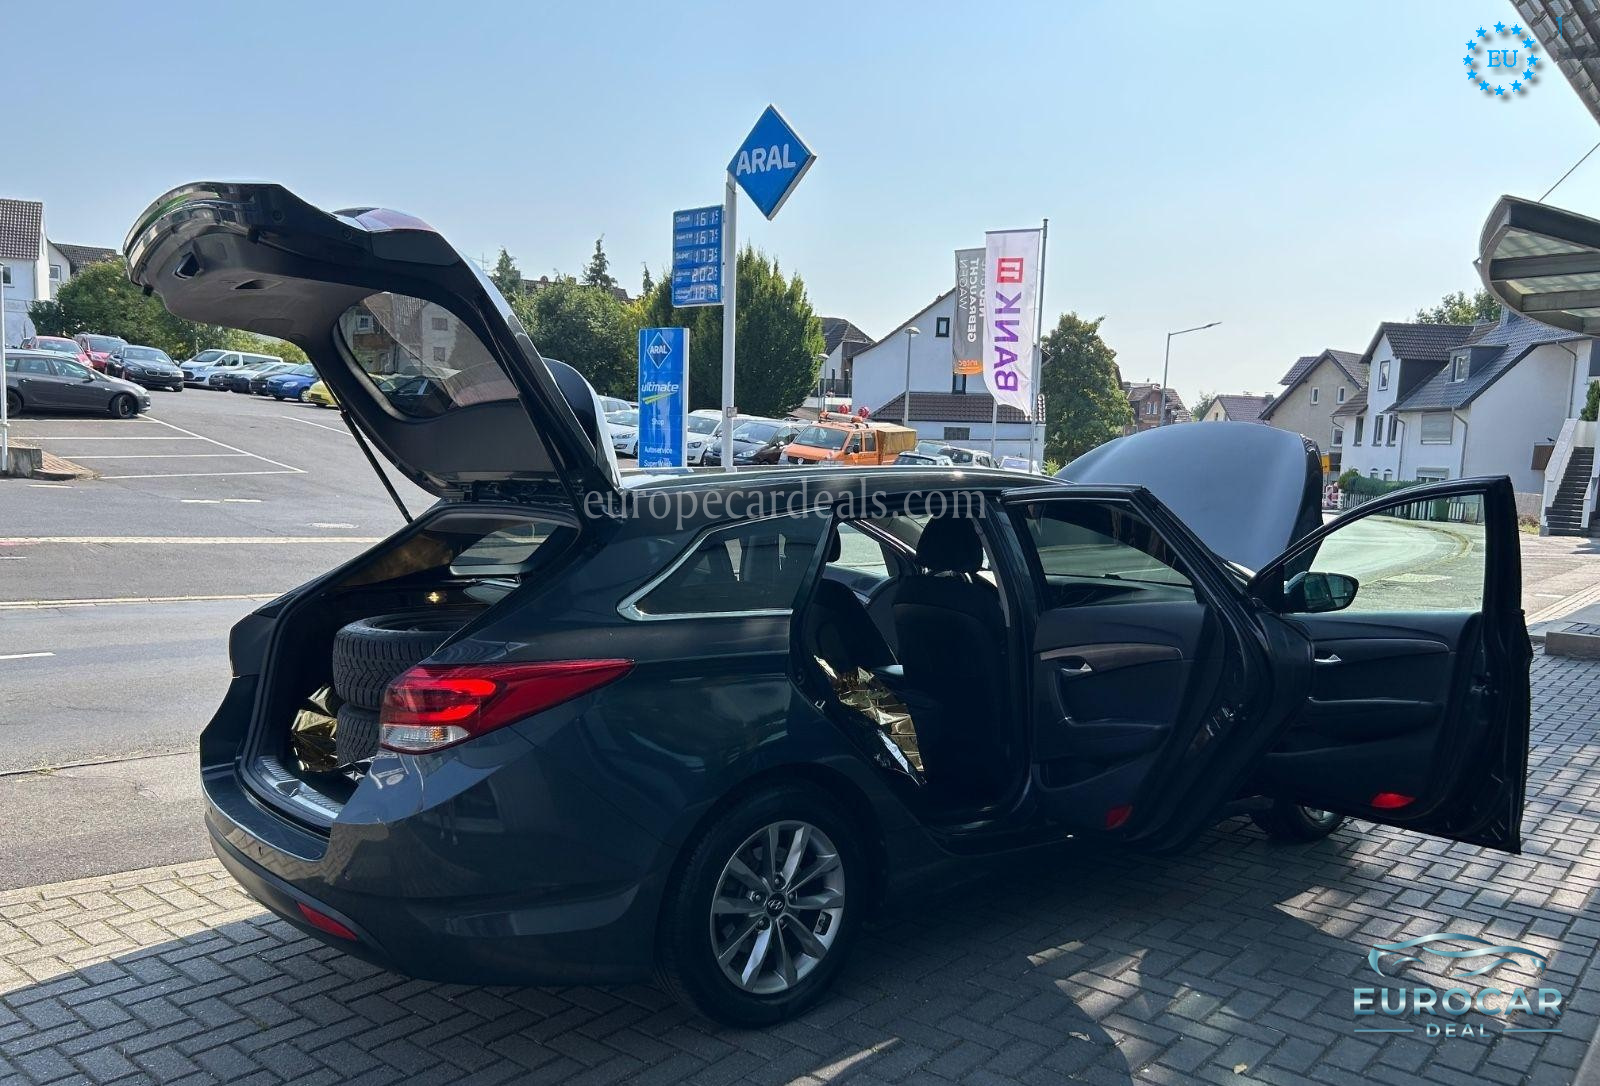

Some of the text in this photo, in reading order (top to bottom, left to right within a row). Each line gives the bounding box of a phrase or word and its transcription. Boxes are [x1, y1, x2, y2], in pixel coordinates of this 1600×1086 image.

[736, 144, 796, 176] ARAL
[650, 345, 668, 355] ARAL
[641, 381, 679, 392] ultimate
